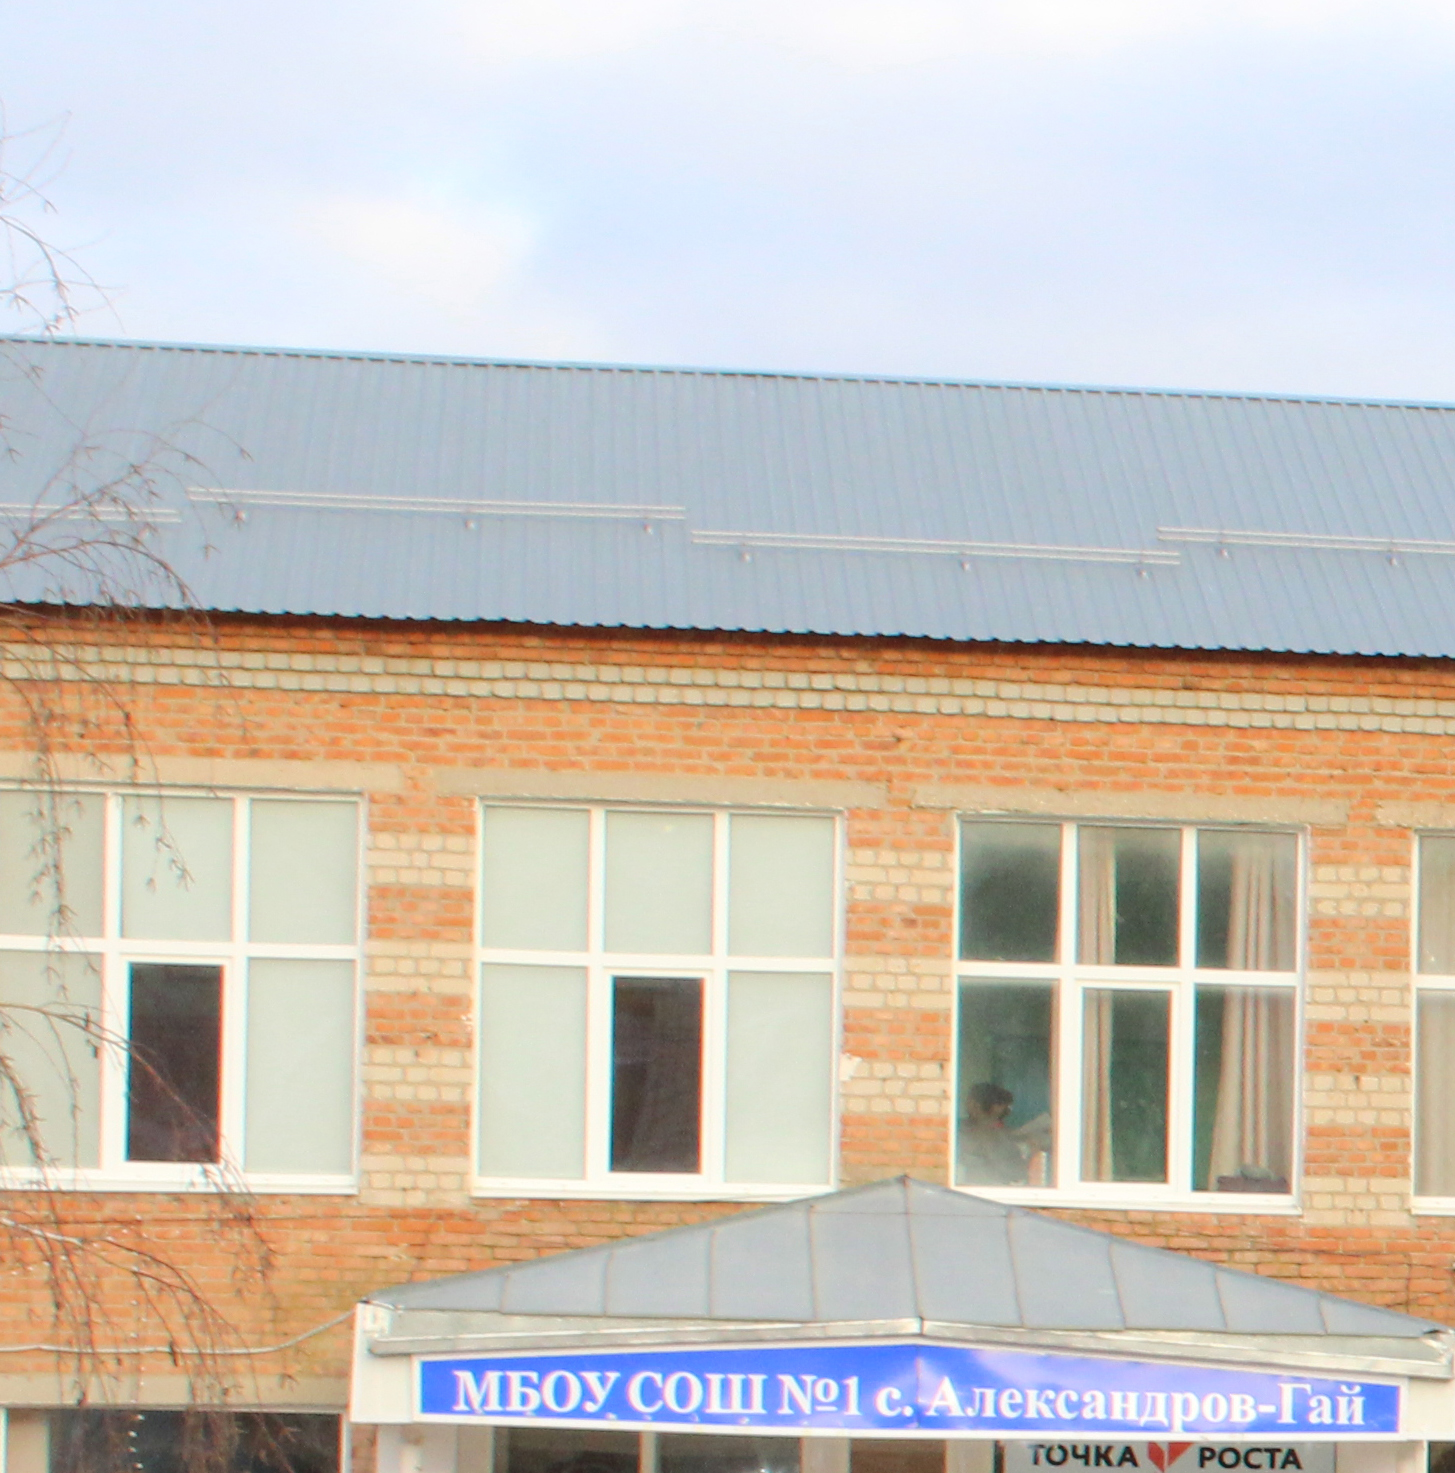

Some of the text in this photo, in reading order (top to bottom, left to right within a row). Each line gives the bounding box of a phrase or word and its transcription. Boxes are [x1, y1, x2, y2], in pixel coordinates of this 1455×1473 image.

[454, 1370, 620, 1413] МБОУ
[627, 1372, 768, 1415] СОШ
[875, 1386, 914, 1417] с.
[927, 1375, 1366, 1431] Александров-Гай
[1030, 1443, 1303, 1470] ТОЧКА РОСТА
